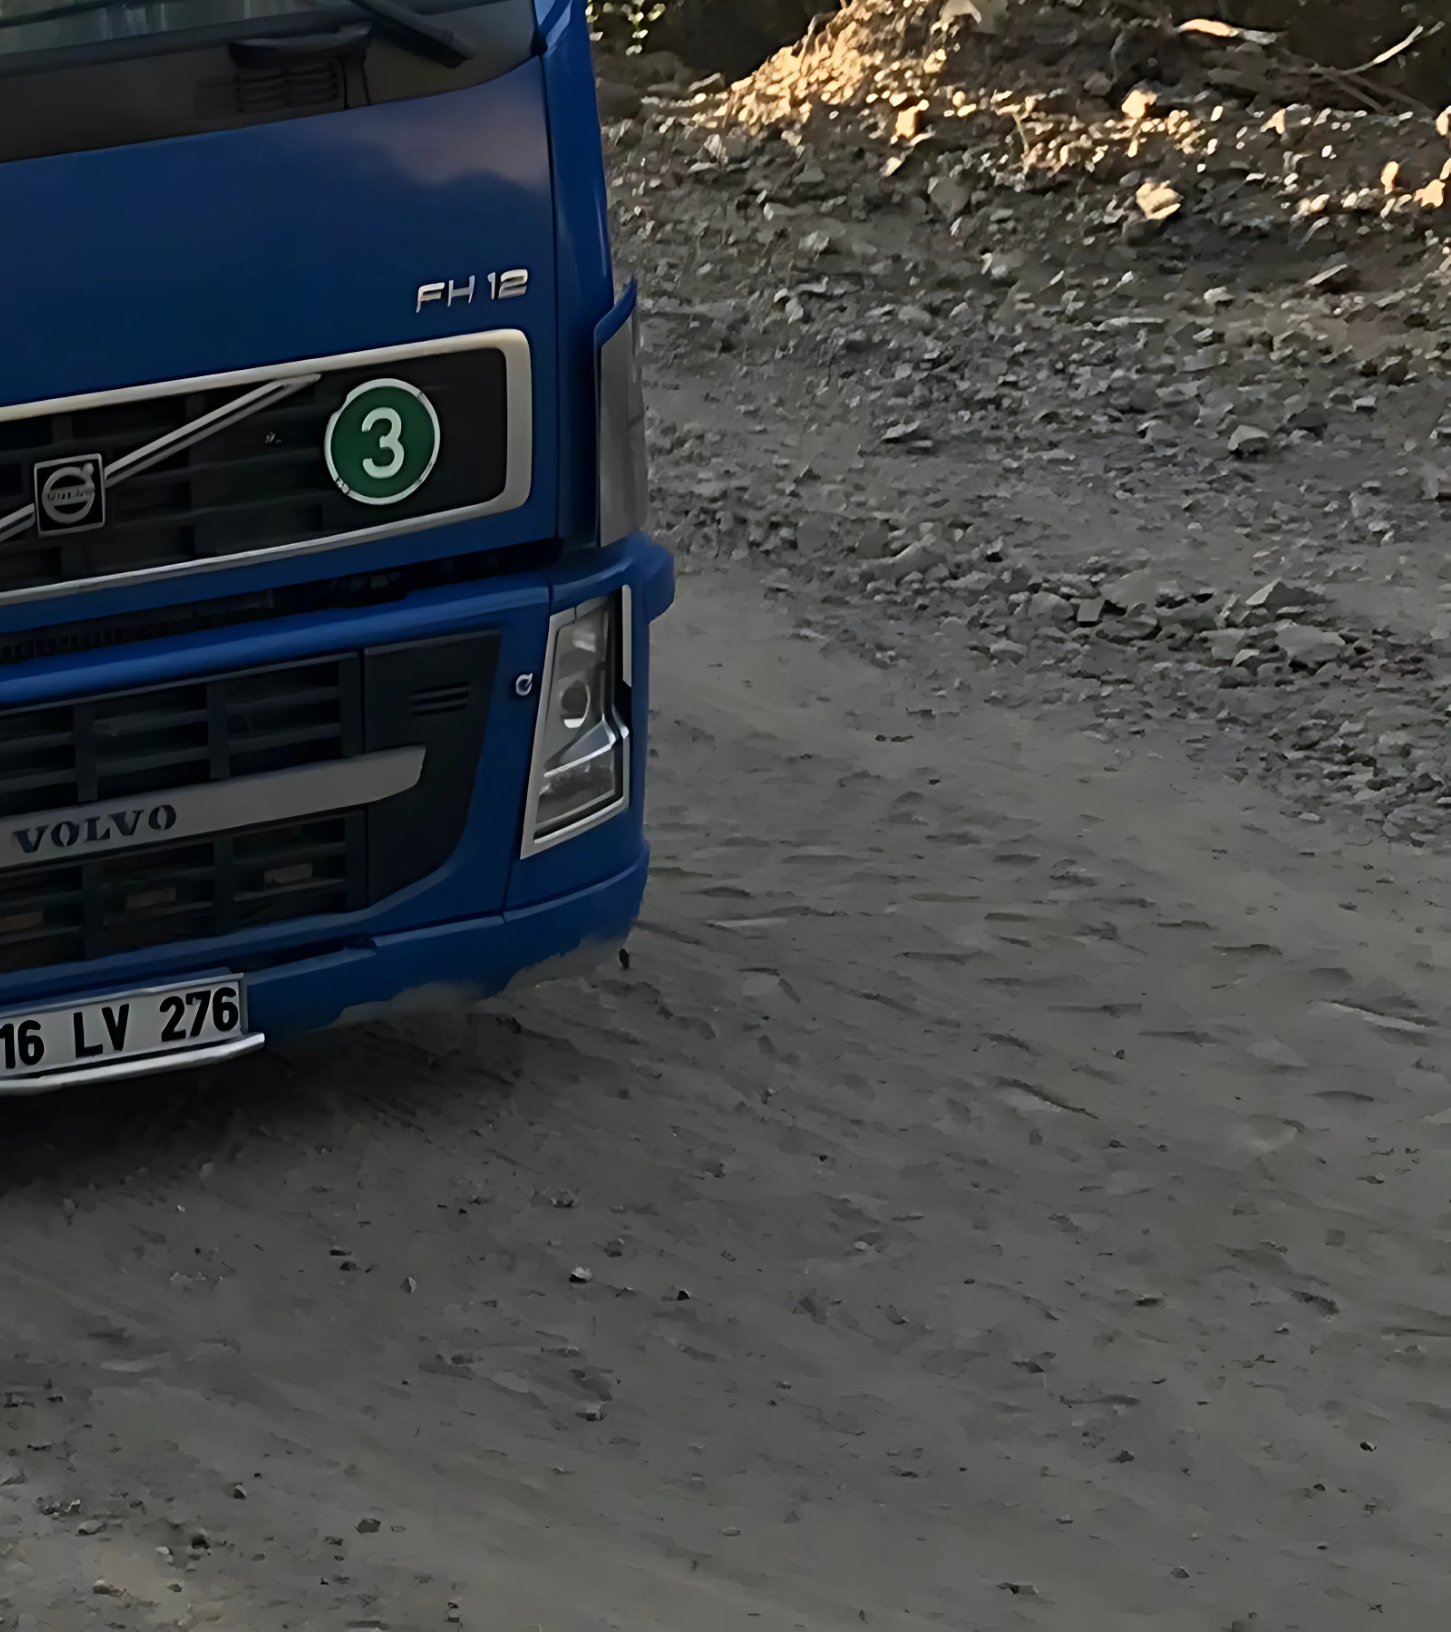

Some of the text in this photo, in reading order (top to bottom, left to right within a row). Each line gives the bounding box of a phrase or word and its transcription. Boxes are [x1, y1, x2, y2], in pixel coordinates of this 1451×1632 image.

[415, 268, 529, 314] FH 12
[361, 406, 405, 480] 3
[11, 804, 177, 855] VOLVO
[73, 1003, 130, 1058] LV
[159, 986, 239, 1042] 276
